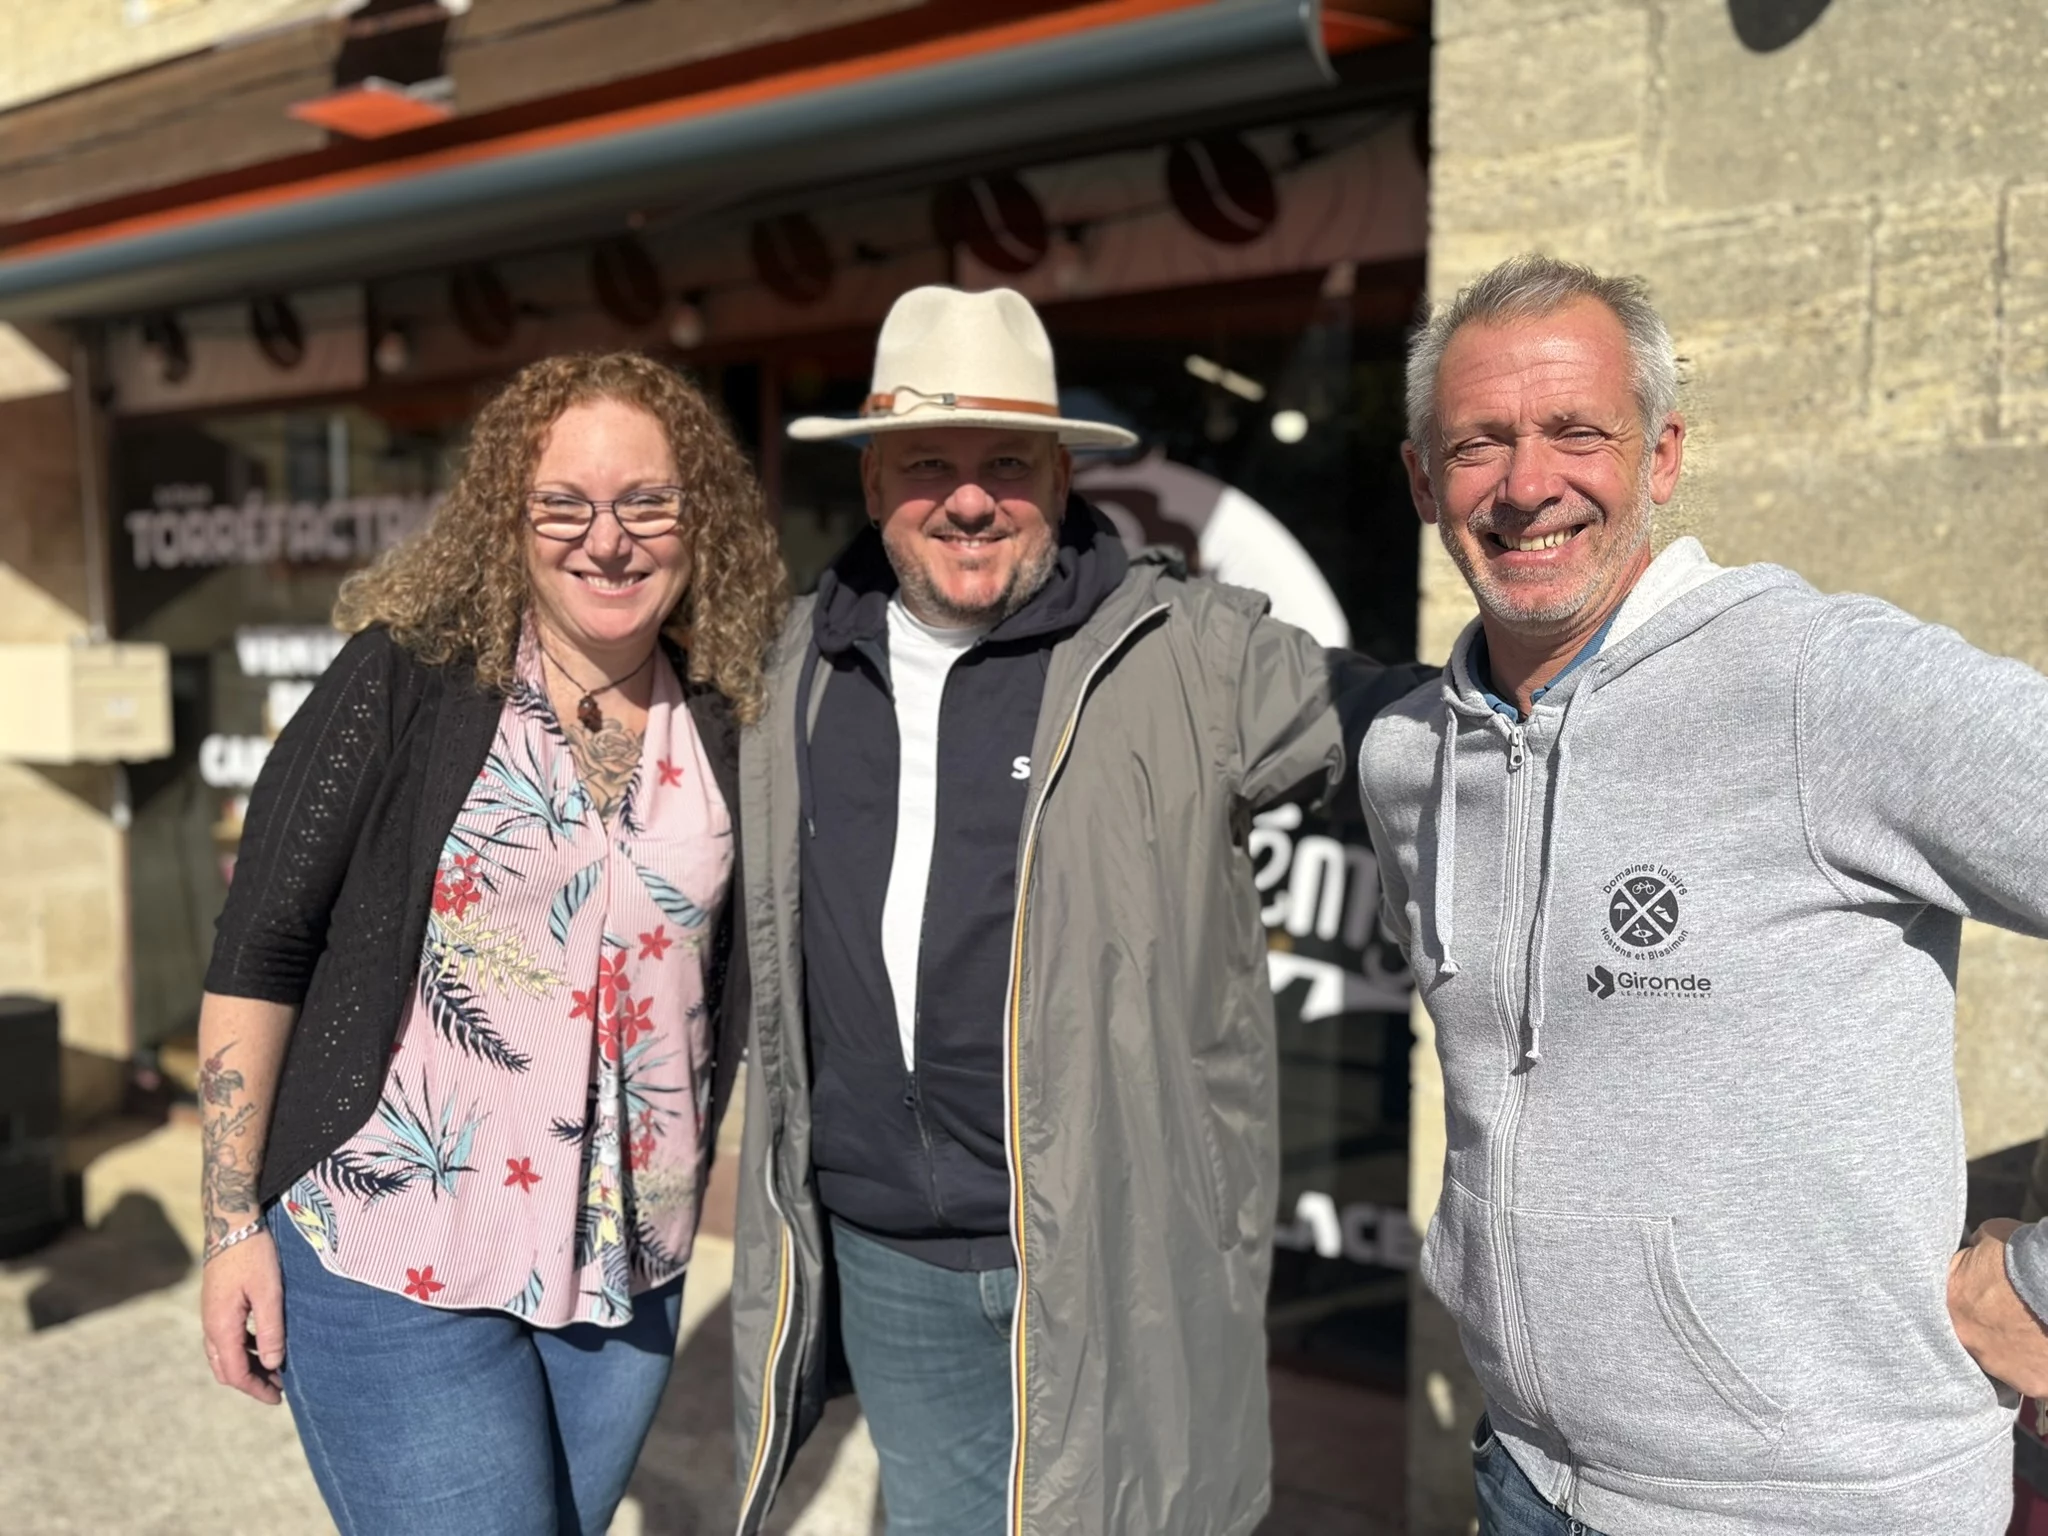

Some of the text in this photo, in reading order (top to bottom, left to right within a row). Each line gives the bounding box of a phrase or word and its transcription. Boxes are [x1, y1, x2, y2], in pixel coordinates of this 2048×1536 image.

[1602, 863, 1688, 896] Domaines loisirs
[1600, 927, 1689, 961] Hostens et Blasimon
[1617, 971, 1712, 991] Gironde
